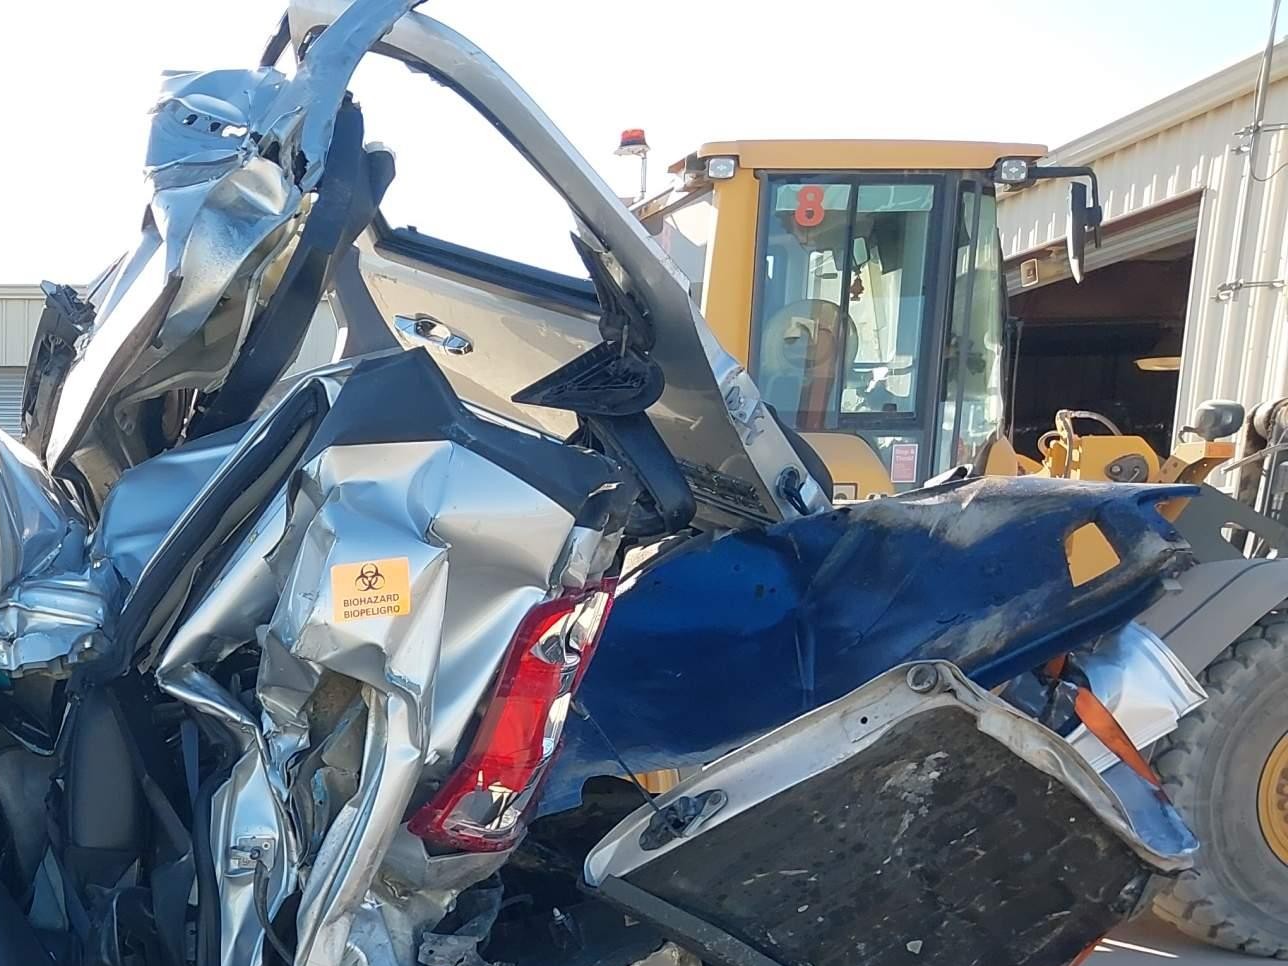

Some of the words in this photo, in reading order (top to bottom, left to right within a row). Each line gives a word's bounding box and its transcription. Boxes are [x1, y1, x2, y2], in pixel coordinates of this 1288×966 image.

[795, 186, 824, 227] 8
[343, 593, 400, 607] BIOHAZARD
[343, 605, 400, 619] BIOPELIGRO
